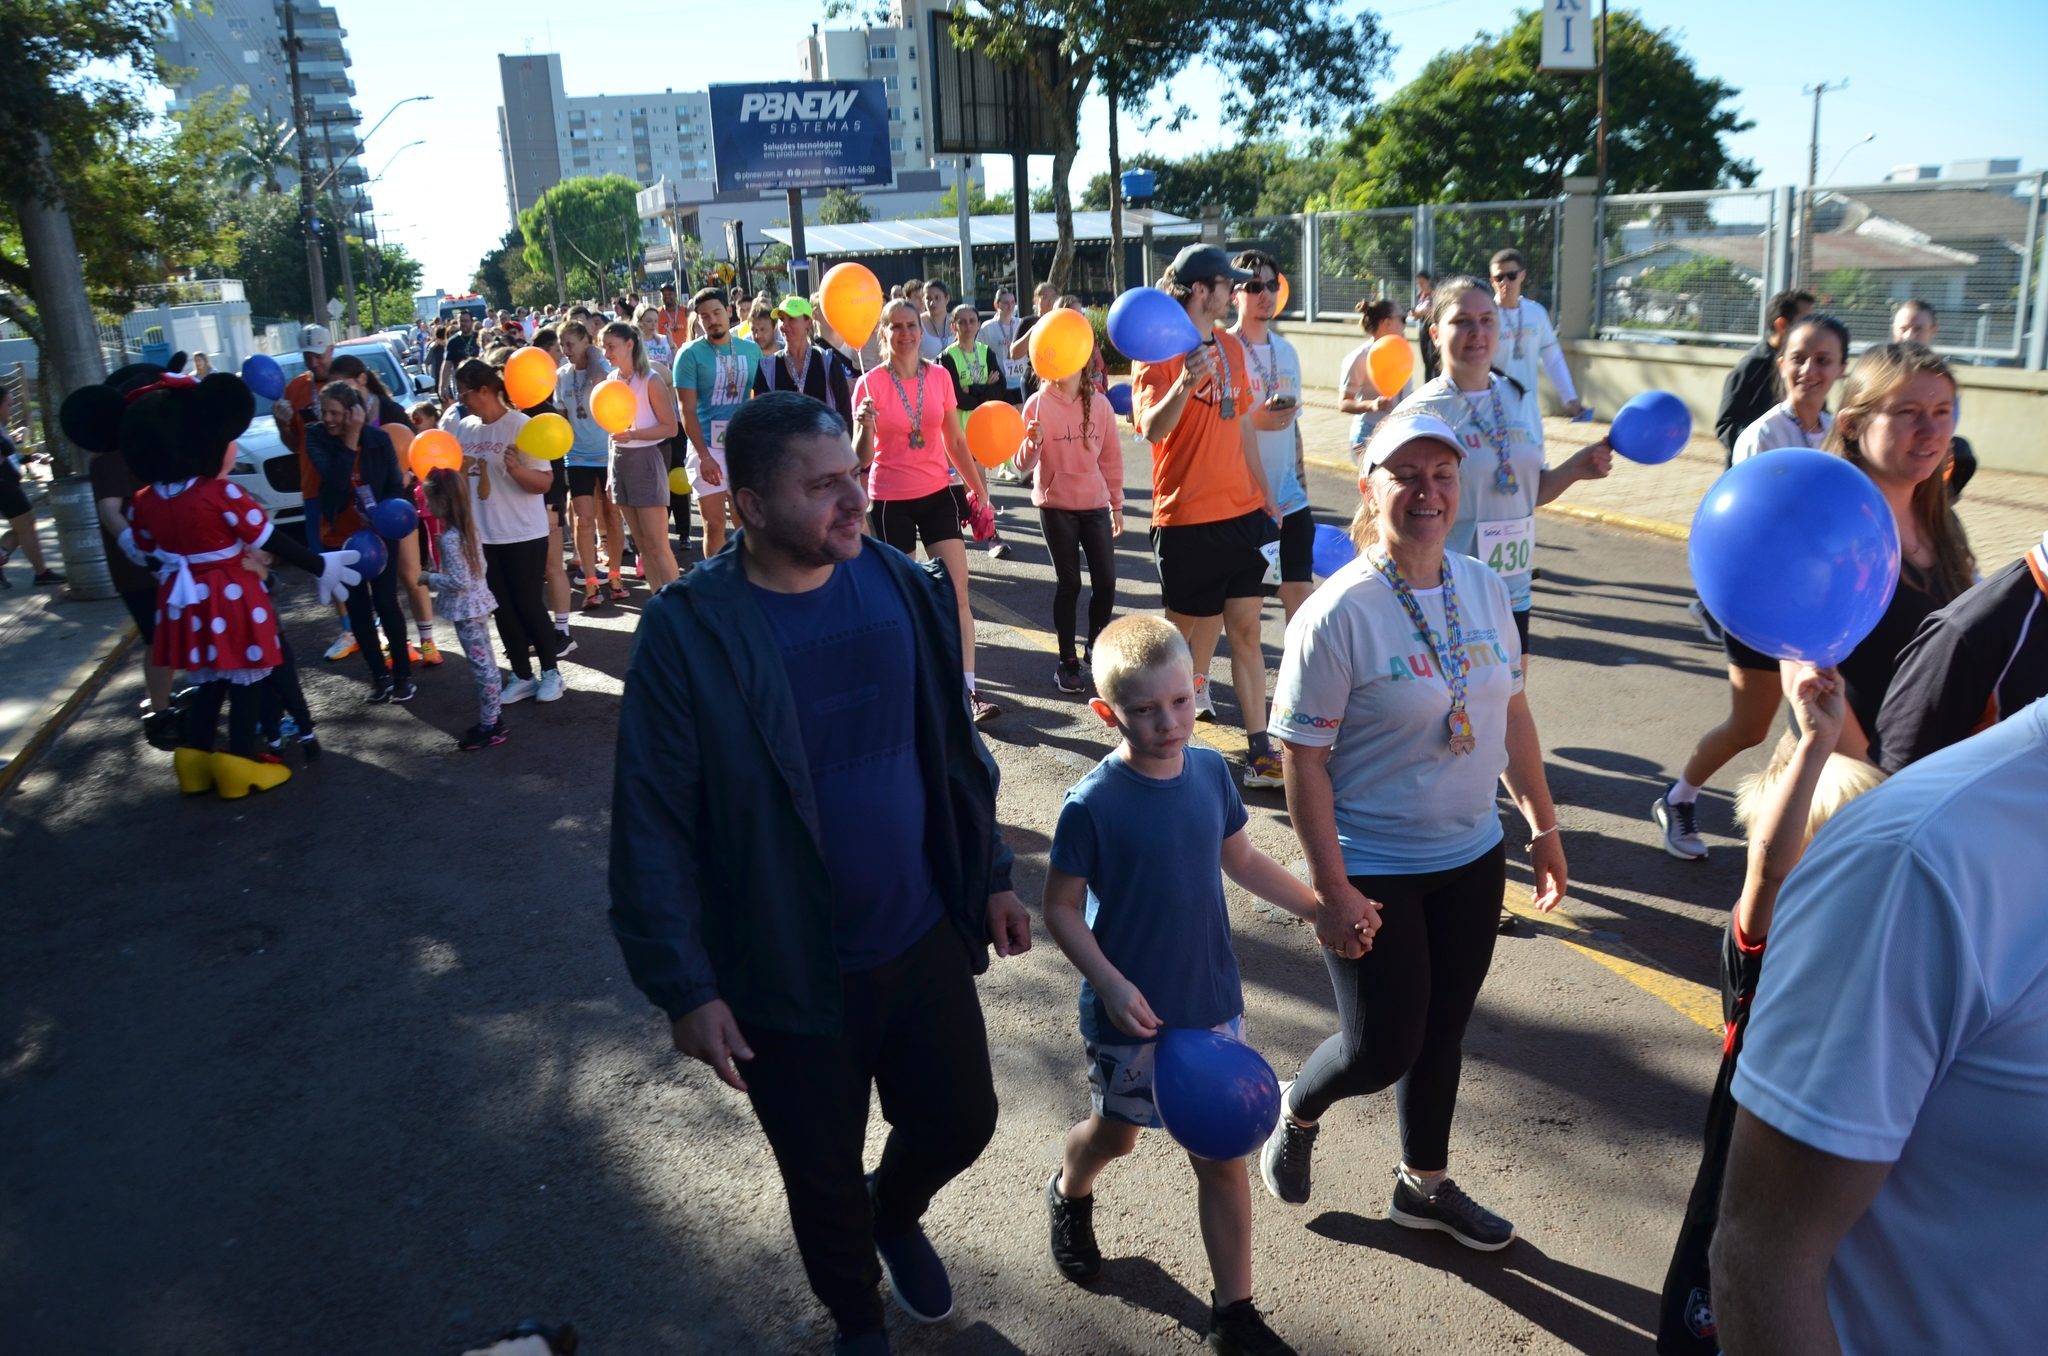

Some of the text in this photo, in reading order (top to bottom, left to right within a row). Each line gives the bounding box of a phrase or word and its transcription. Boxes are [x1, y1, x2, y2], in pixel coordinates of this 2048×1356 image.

[740, 89, 859, 123] PBNEW
[770, 120, 861, 135] SISTEMAS
[763, 140, 842, 152] Soluções tecnológicas
[763, 151, 775, 159] em
[776, 149, 807, 159] produtos
[742, 170, 784, 180] pbnew.com.br
[839, 165, 875, 175] 3744-3880
[1008, 364, 1024, 375] 746
[1487, 538, 1529, 573] 430
